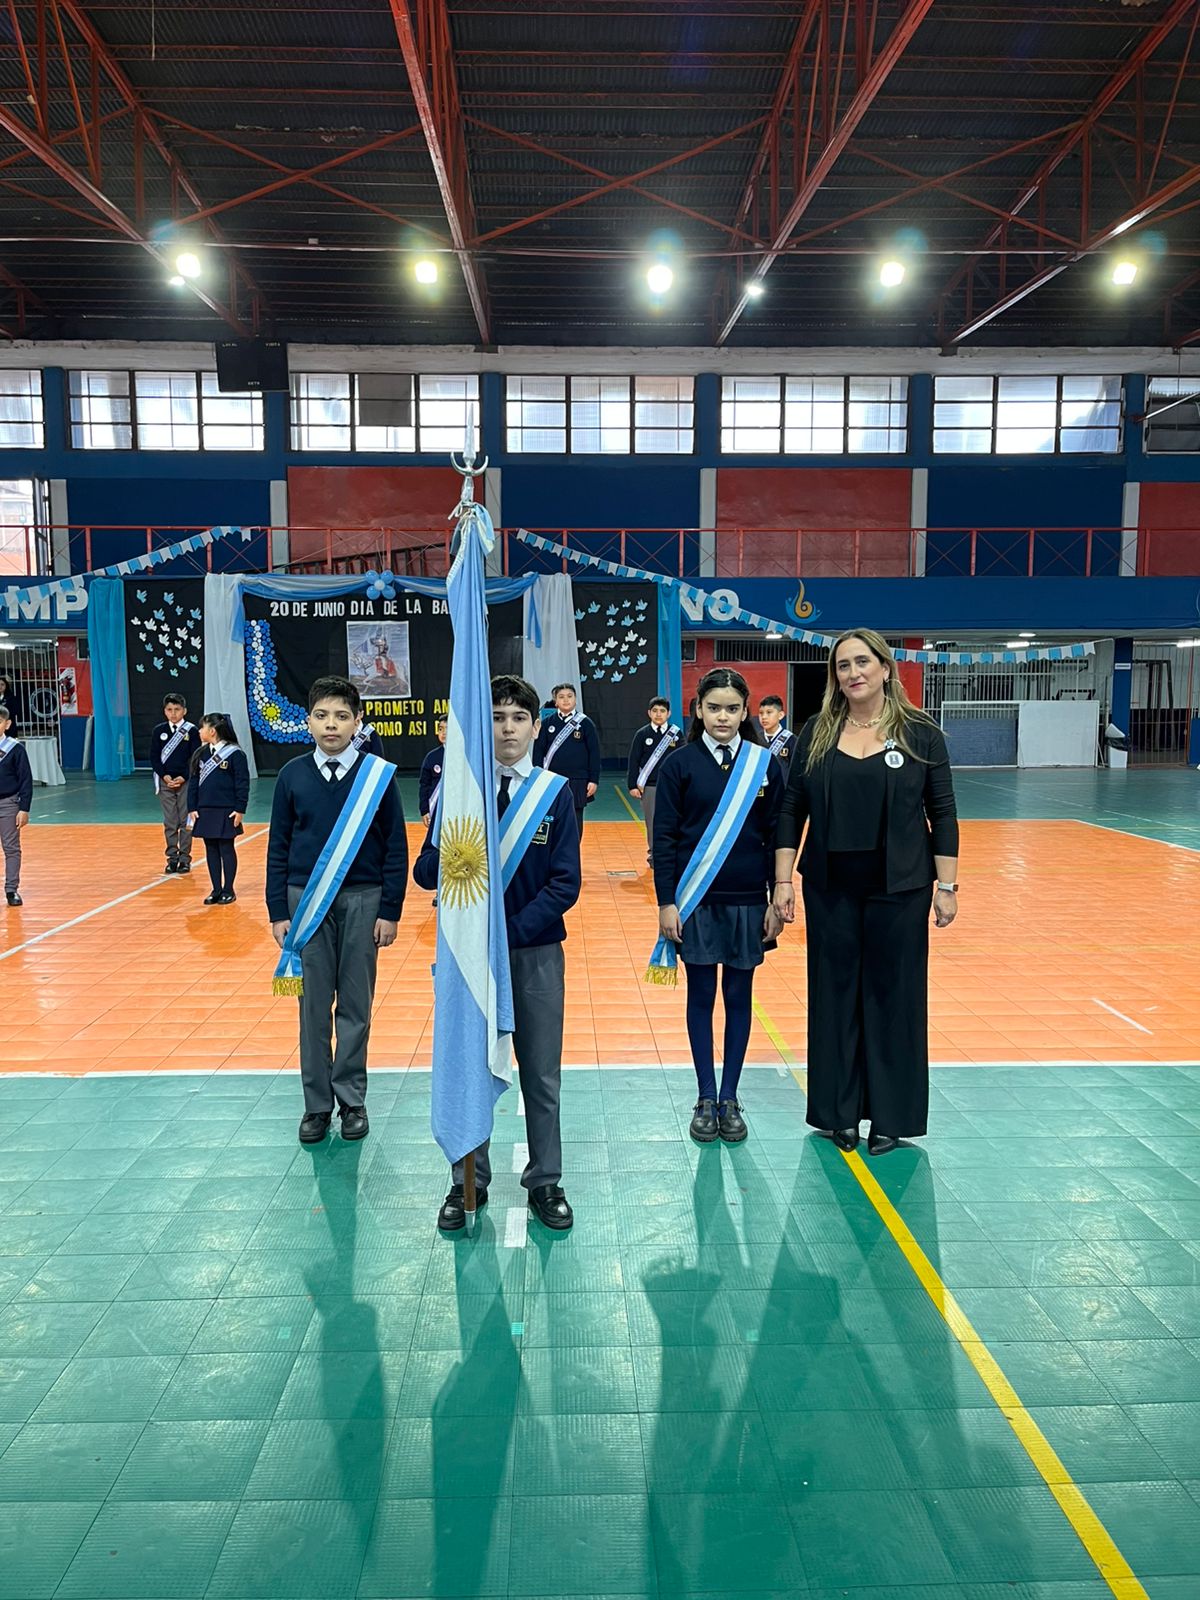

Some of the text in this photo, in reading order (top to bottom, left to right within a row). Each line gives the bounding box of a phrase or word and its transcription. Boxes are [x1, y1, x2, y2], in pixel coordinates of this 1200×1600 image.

[270, 601, 289, 617] 20
[292, 602, 307, 616] DE
[313, 601, 345, 617] JUNIO
[350, 601, 374, 616] DIA
[383, 600, 398, 615] DE
[405, 599, 422, 614] LA
[365, 699, 424, 716] PROMETO
[408, 720, 427, 735] ASI
